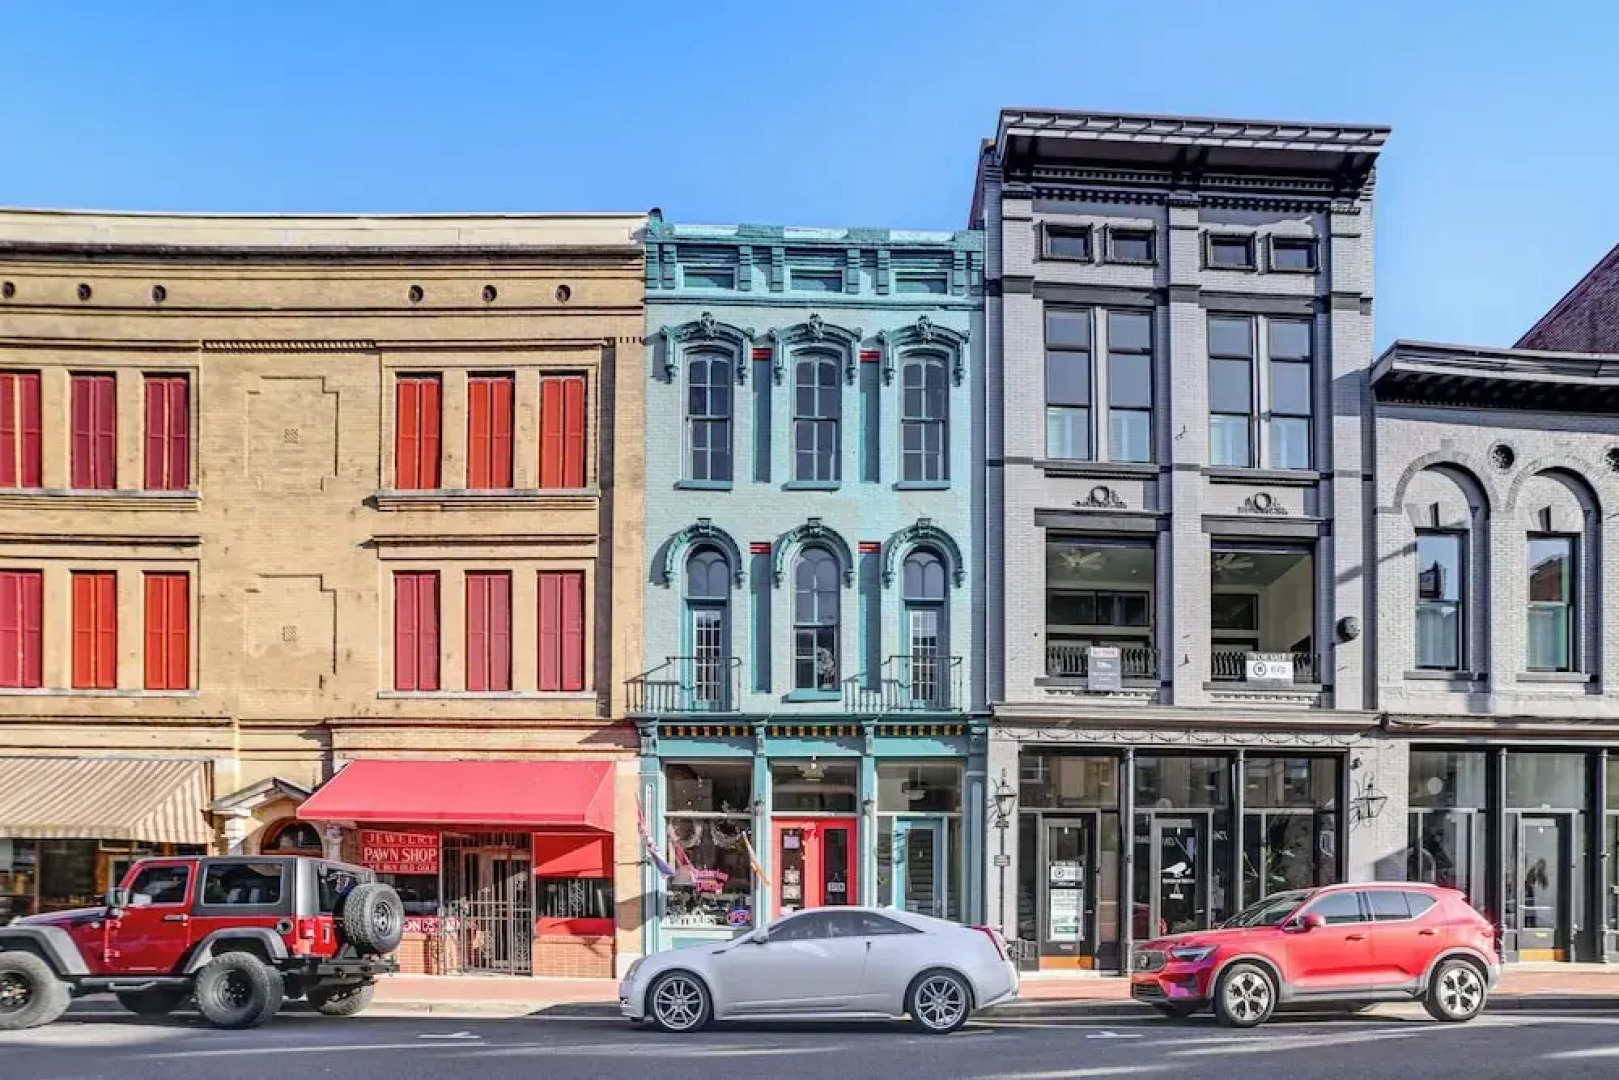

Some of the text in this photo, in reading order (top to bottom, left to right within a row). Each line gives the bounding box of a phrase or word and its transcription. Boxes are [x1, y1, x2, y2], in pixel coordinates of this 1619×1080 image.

[367, 833, 437, 845] JEWELRY
[363, 846, 438, 862] PAWN SHOP
